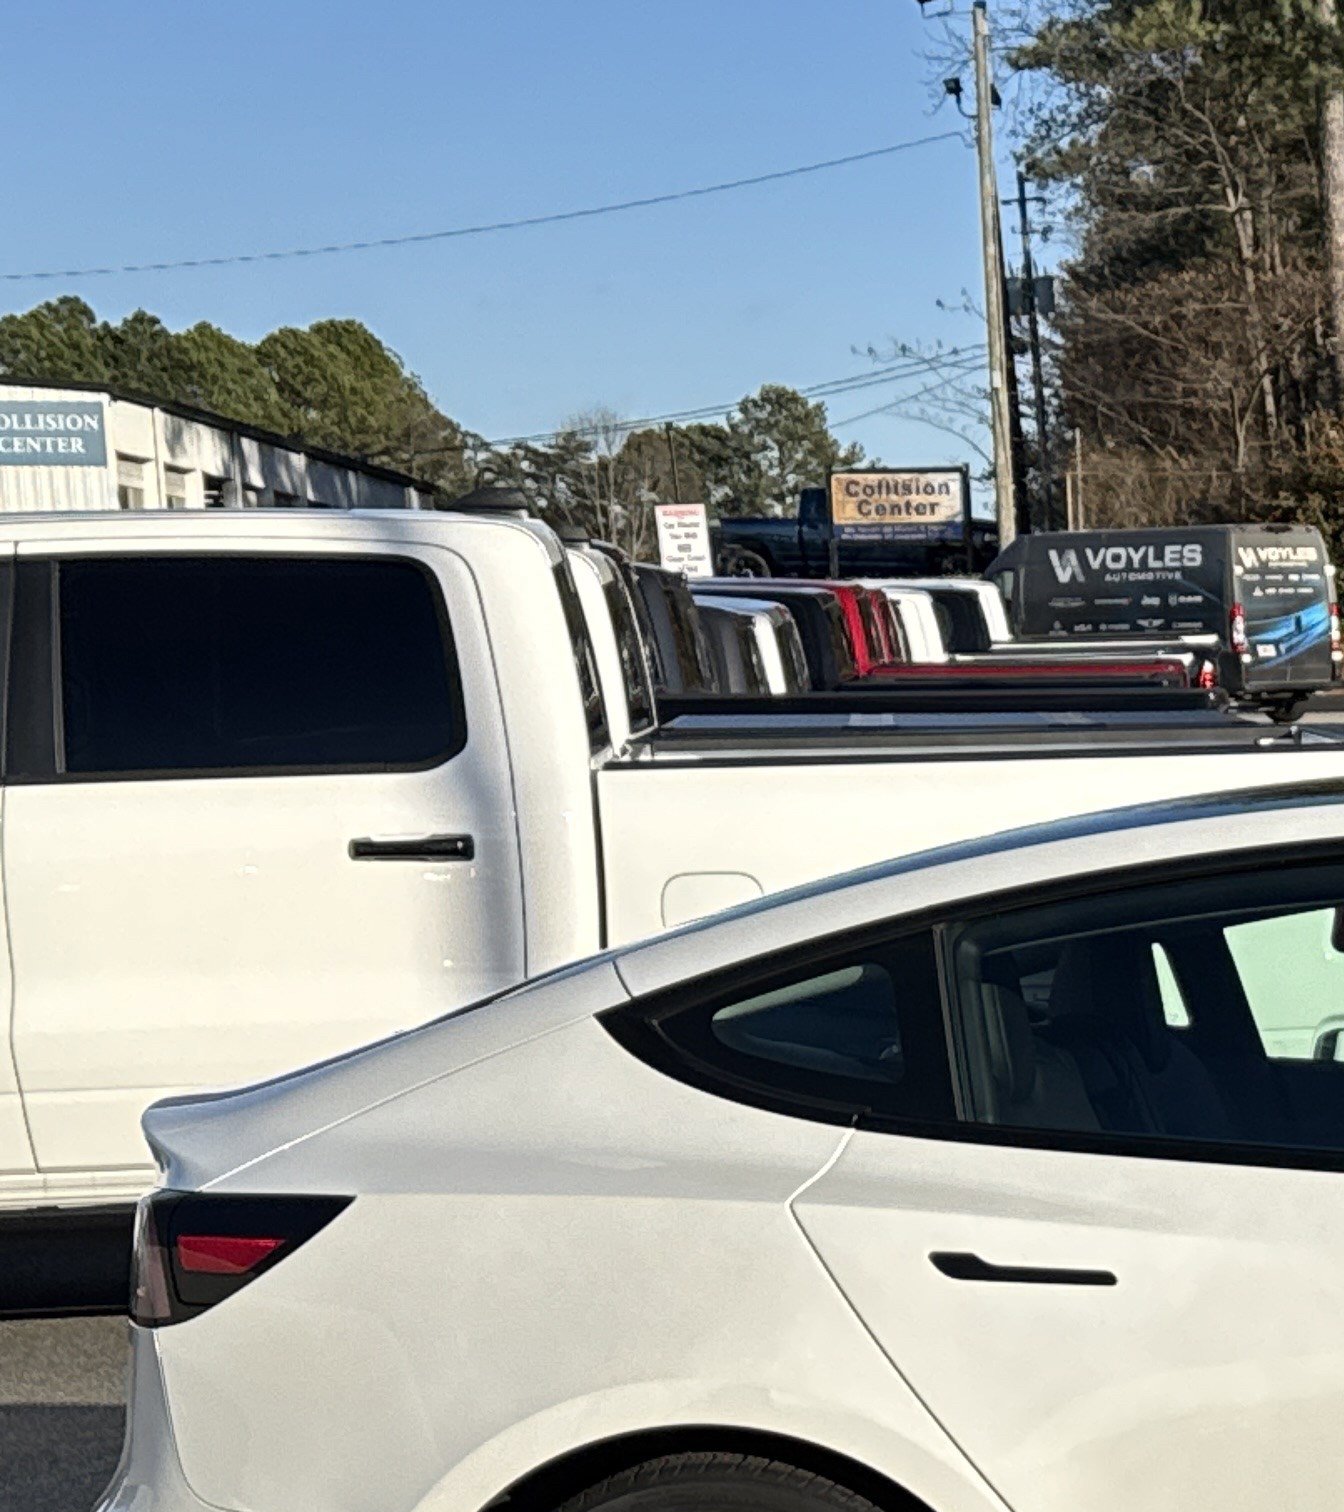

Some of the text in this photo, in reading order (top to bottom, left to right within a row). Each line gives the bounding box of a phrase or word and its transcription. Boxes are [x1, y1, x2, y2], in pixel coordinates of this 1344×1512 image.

[0, 413, 99, 431] OLLISION
[0, 436, 87, 453] CENTER
[845, 478, 951, 498] Collision
[857, 499, 940, 516] Center
[1085, 543, 1203, 569] VOYLES
